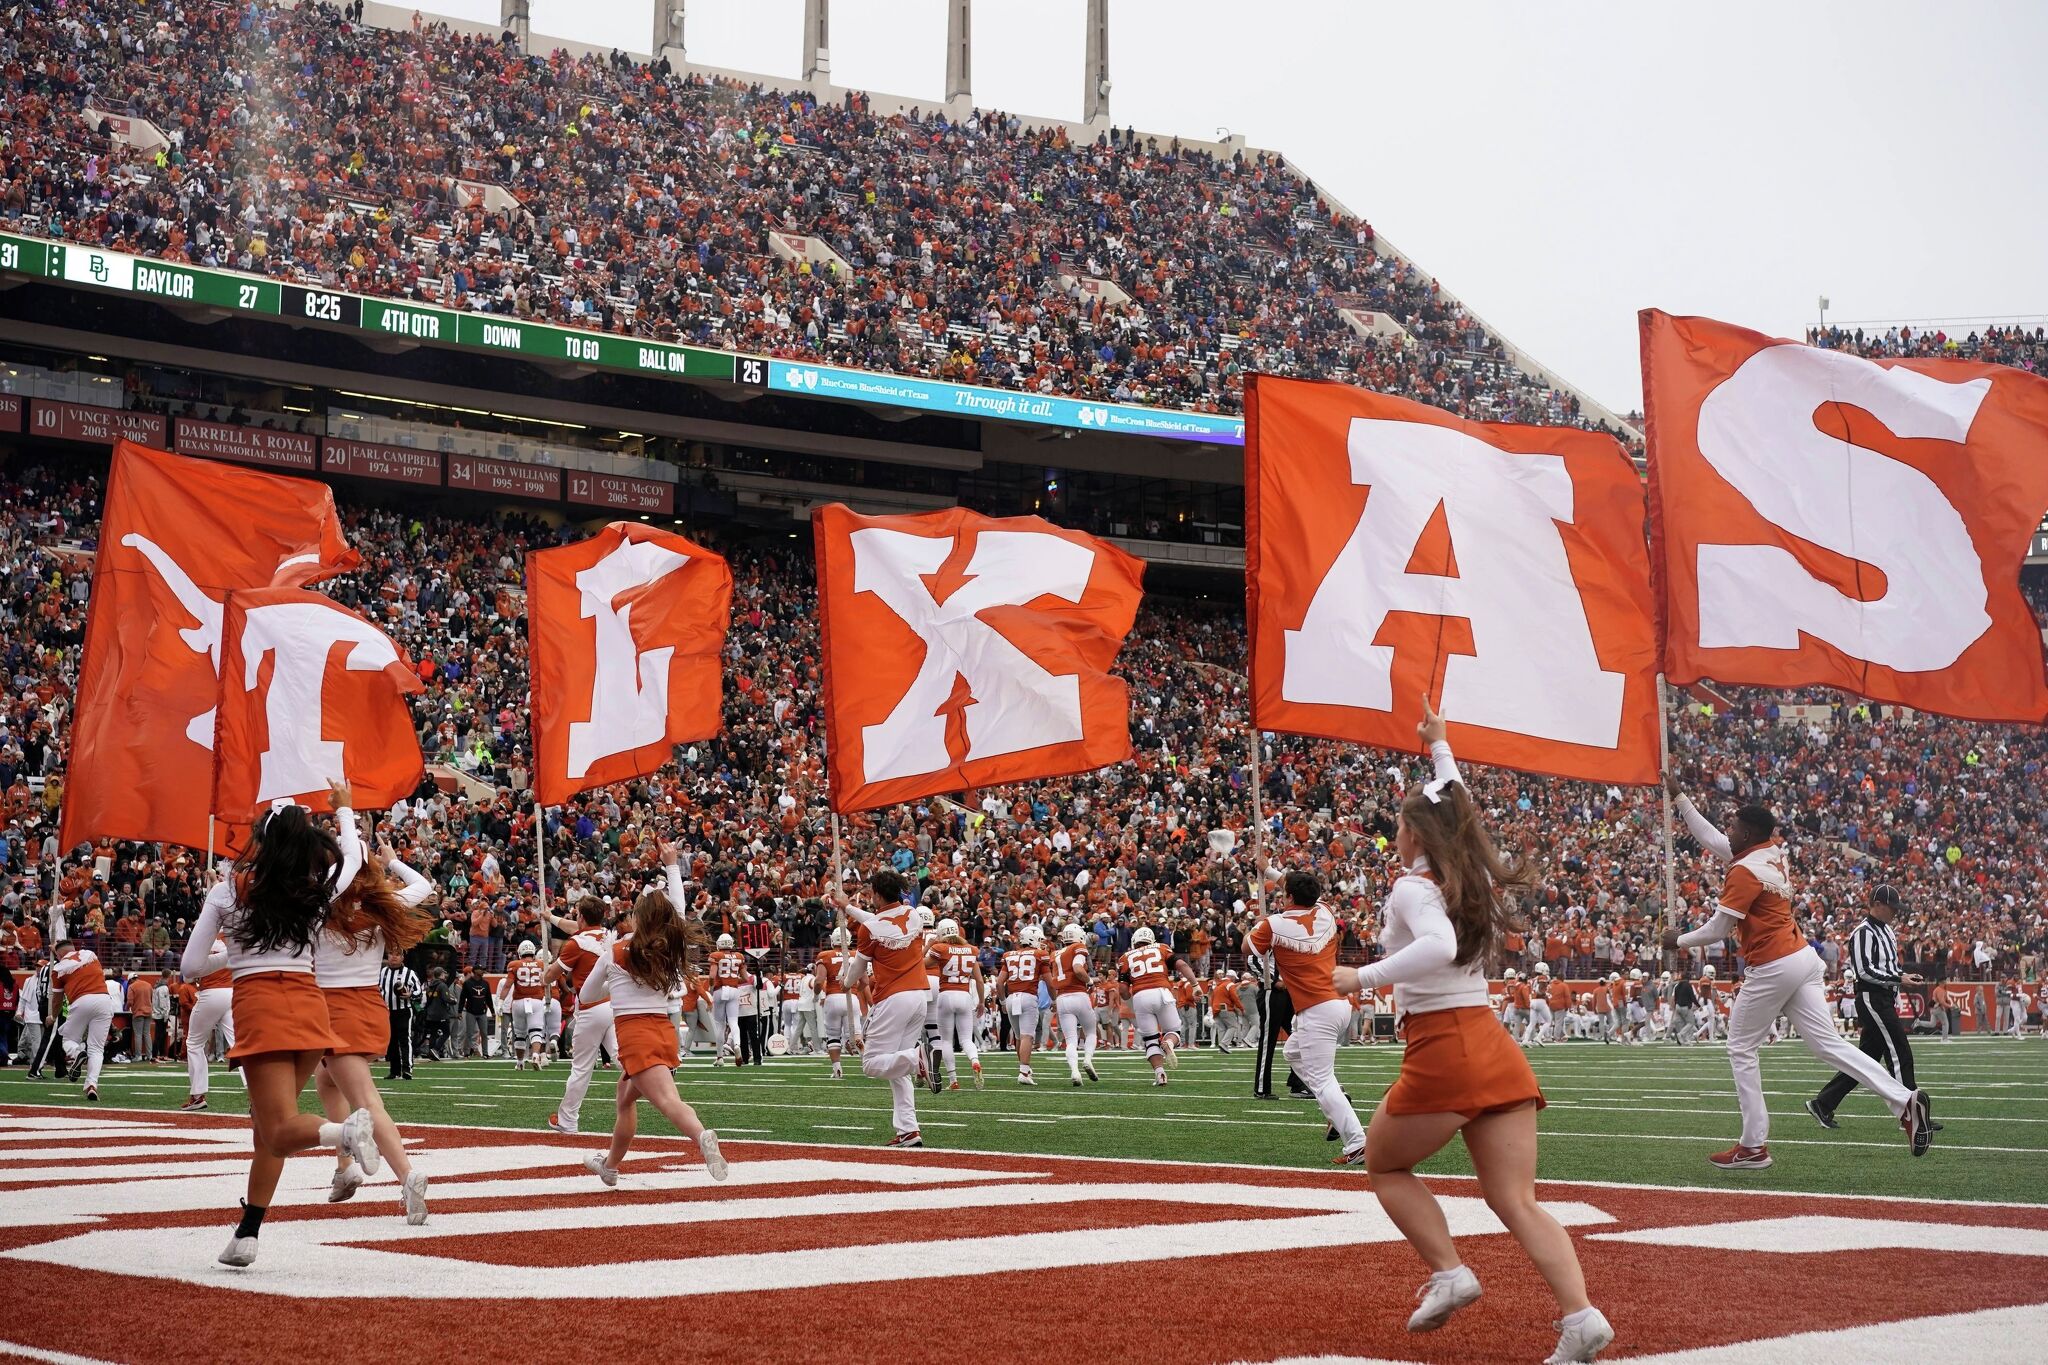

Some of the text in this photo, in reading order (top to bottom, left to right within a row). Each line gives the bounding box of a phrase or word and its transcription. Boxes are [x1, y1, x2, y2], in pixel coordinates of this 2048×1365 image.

[1, 243, 18, 269] 31
[137, 267, 194, 299] BAYLOR
[239, 285, 258, 309] 27
[305, 292, 341, 321] 8:25
[381, 308, 439, 339] 4TH QTR
[483, 324, 521, 349] DOWN
[565, 337, 600, 360] TO GO
[639, 348, 685, 373] BALL ON
[743, 360, 761, 384] 25
[821, 377, 929, 400] BlueCross BlueShield of Texas
[955, 391, 1016, 415] Through
[1019, 398, 1029, 413] it
[37, 408, 56, 428] 10
[69, 408, 160, 432] VINCE YOUNG
[1110, 414, 1211, 434] BlueCross BlueShield of Texas
[81, 425, 107, 439] 2003
[122, 430, 148, 443] 2005
[179, 423, 313, 453] DARRELL K ROYAL
[179, 439, 312, 465] TEXAS MEMORIAL STADIUM
[326, 446, 346, 466] 20
[352, 446, 440, 468] EARL CAMPBELL
[368, 462, 390, 474] 1974
[402, 465, 424, 478] 1977
[452, 463, 471, 481] 34
[478, 462, 559, 483] RICKY WILLIAMS
[492, 477, 513, 489] 1995
[524, 481, 545, 494] 1998
[572, 478, 588, 496] 12
[601, 478, 665, 497] COLT McCOY
[608, 492, 628, 504] 2005
[639, 496, 660, 508] 2009
[1697, 343, 1993, 674] S
[1282, 417, 1626, 749] A
[848, 527, 1096, 783] X
[240, 602, 399, 804] T
[942, 955, 976, 983] 45
[1005, 955, 1037, 981] 58
[1127, 948, 1164, 978] 62
[516, 967, 542, 987] 92
